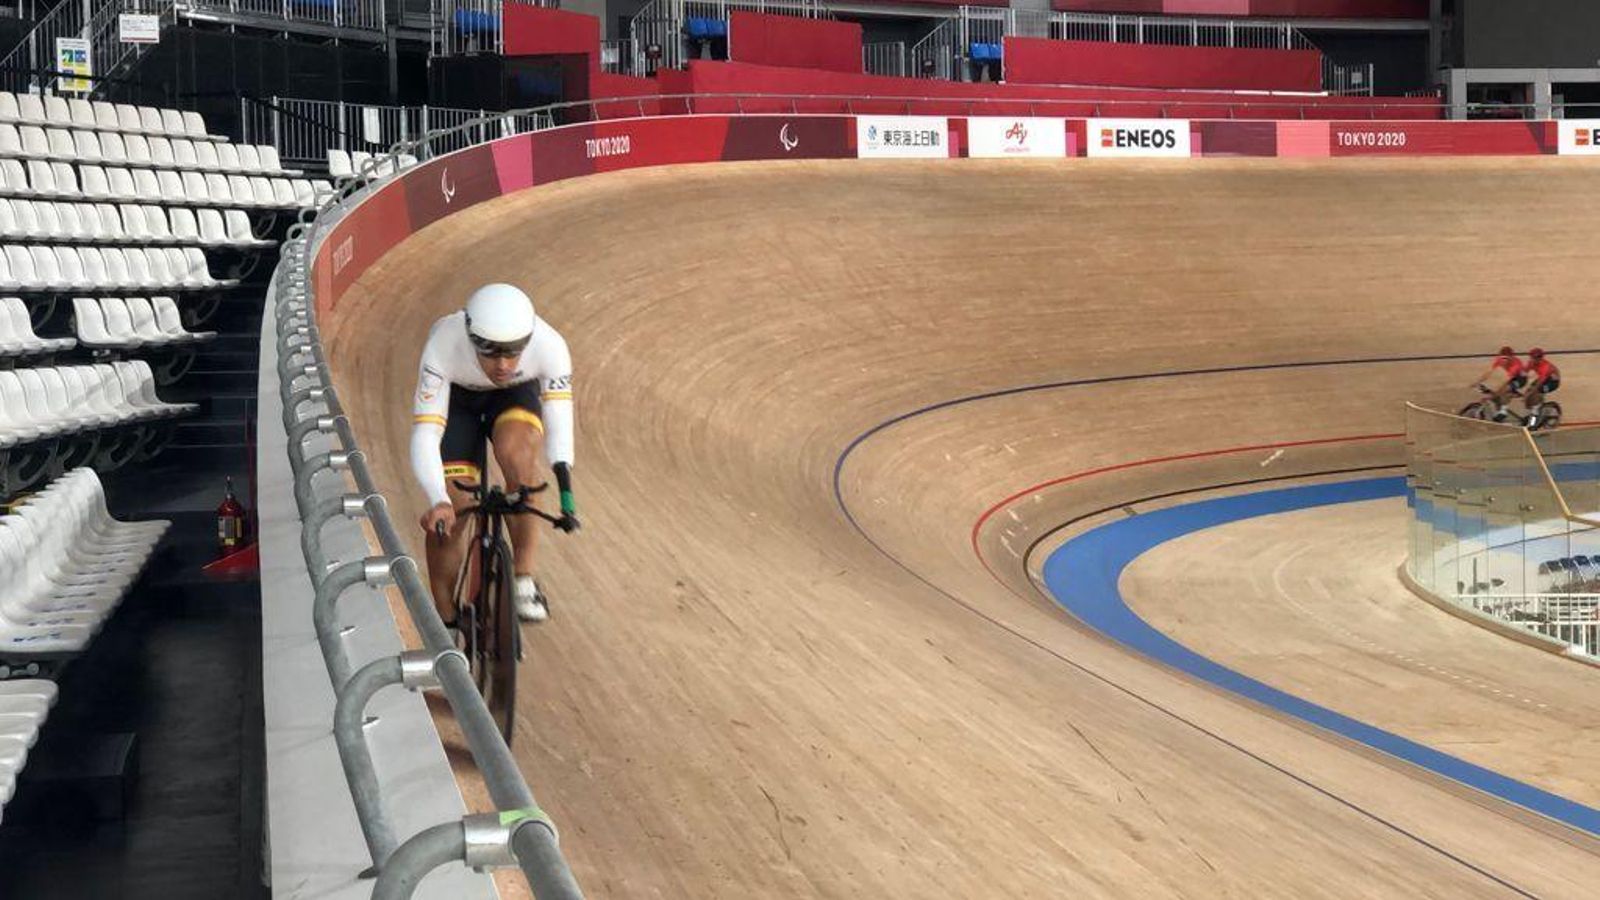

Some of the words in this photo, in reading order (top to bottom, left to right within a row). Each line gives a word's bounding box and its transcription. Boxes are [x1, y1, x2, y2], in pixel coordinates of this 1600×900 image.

[585, 138, 611, 158] TOKYO
[611, 135, 630, 155] 2020
[883, 130, 940, 146] 東京海上日動
[1116, 129, 1176, 148] ENEOS
[1337, 132, 1375, 146] TOKYO
[1377, 132, 1406, 146] 2020
